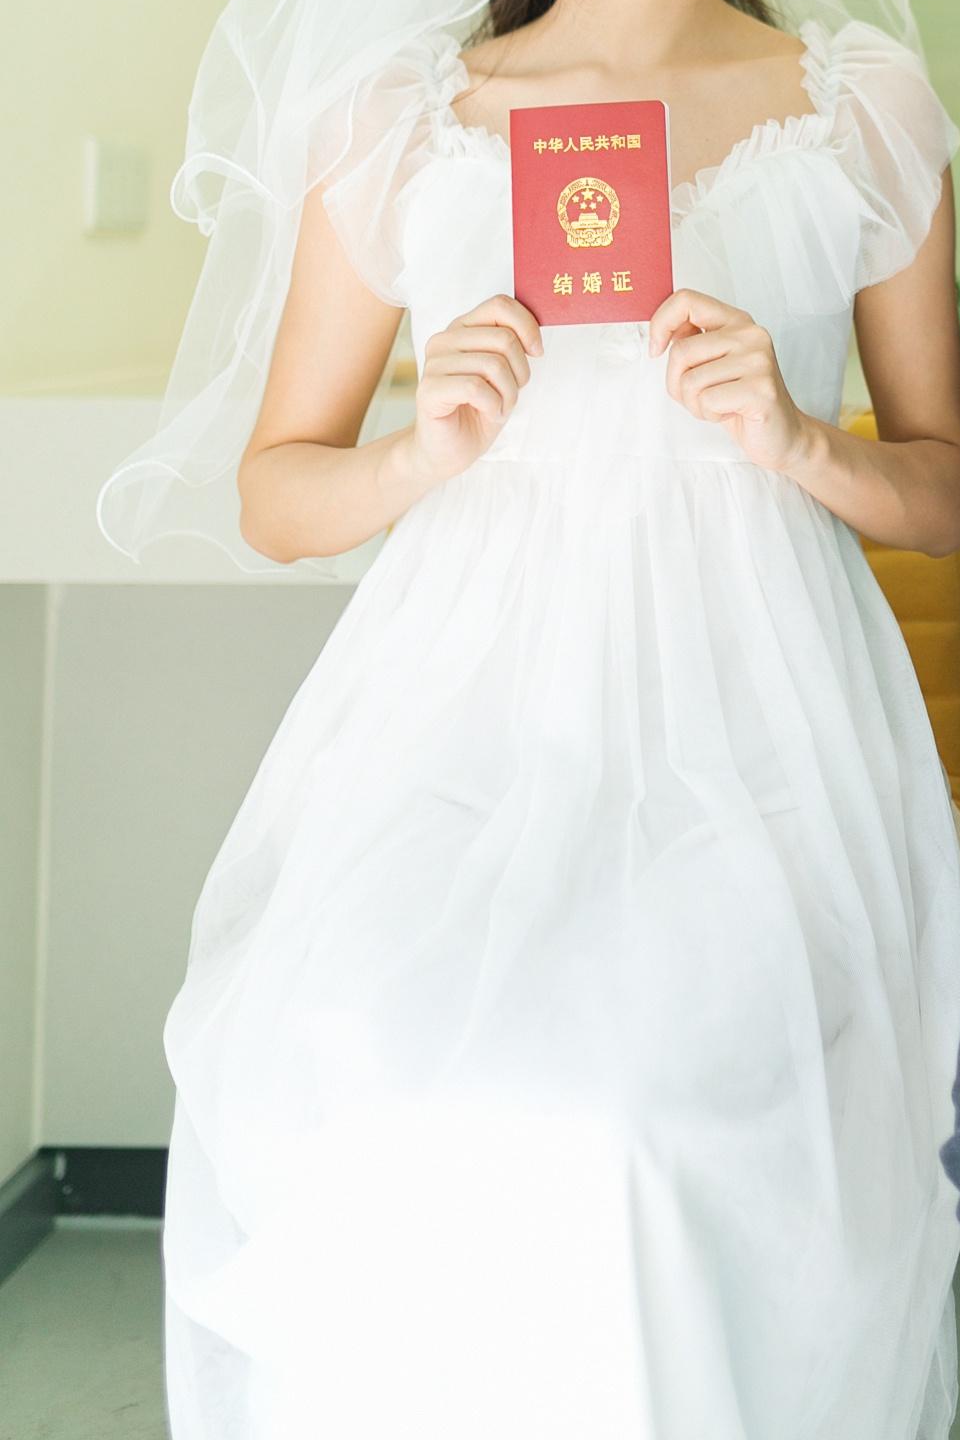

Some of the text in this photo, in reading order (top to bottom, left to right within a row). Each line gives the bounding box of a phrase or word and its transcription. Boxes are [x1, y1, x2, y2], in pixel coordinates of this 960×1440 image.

[533, 134, 641, 154] 中华人民共和国
[553, 271, 633, 295] 结婚证
